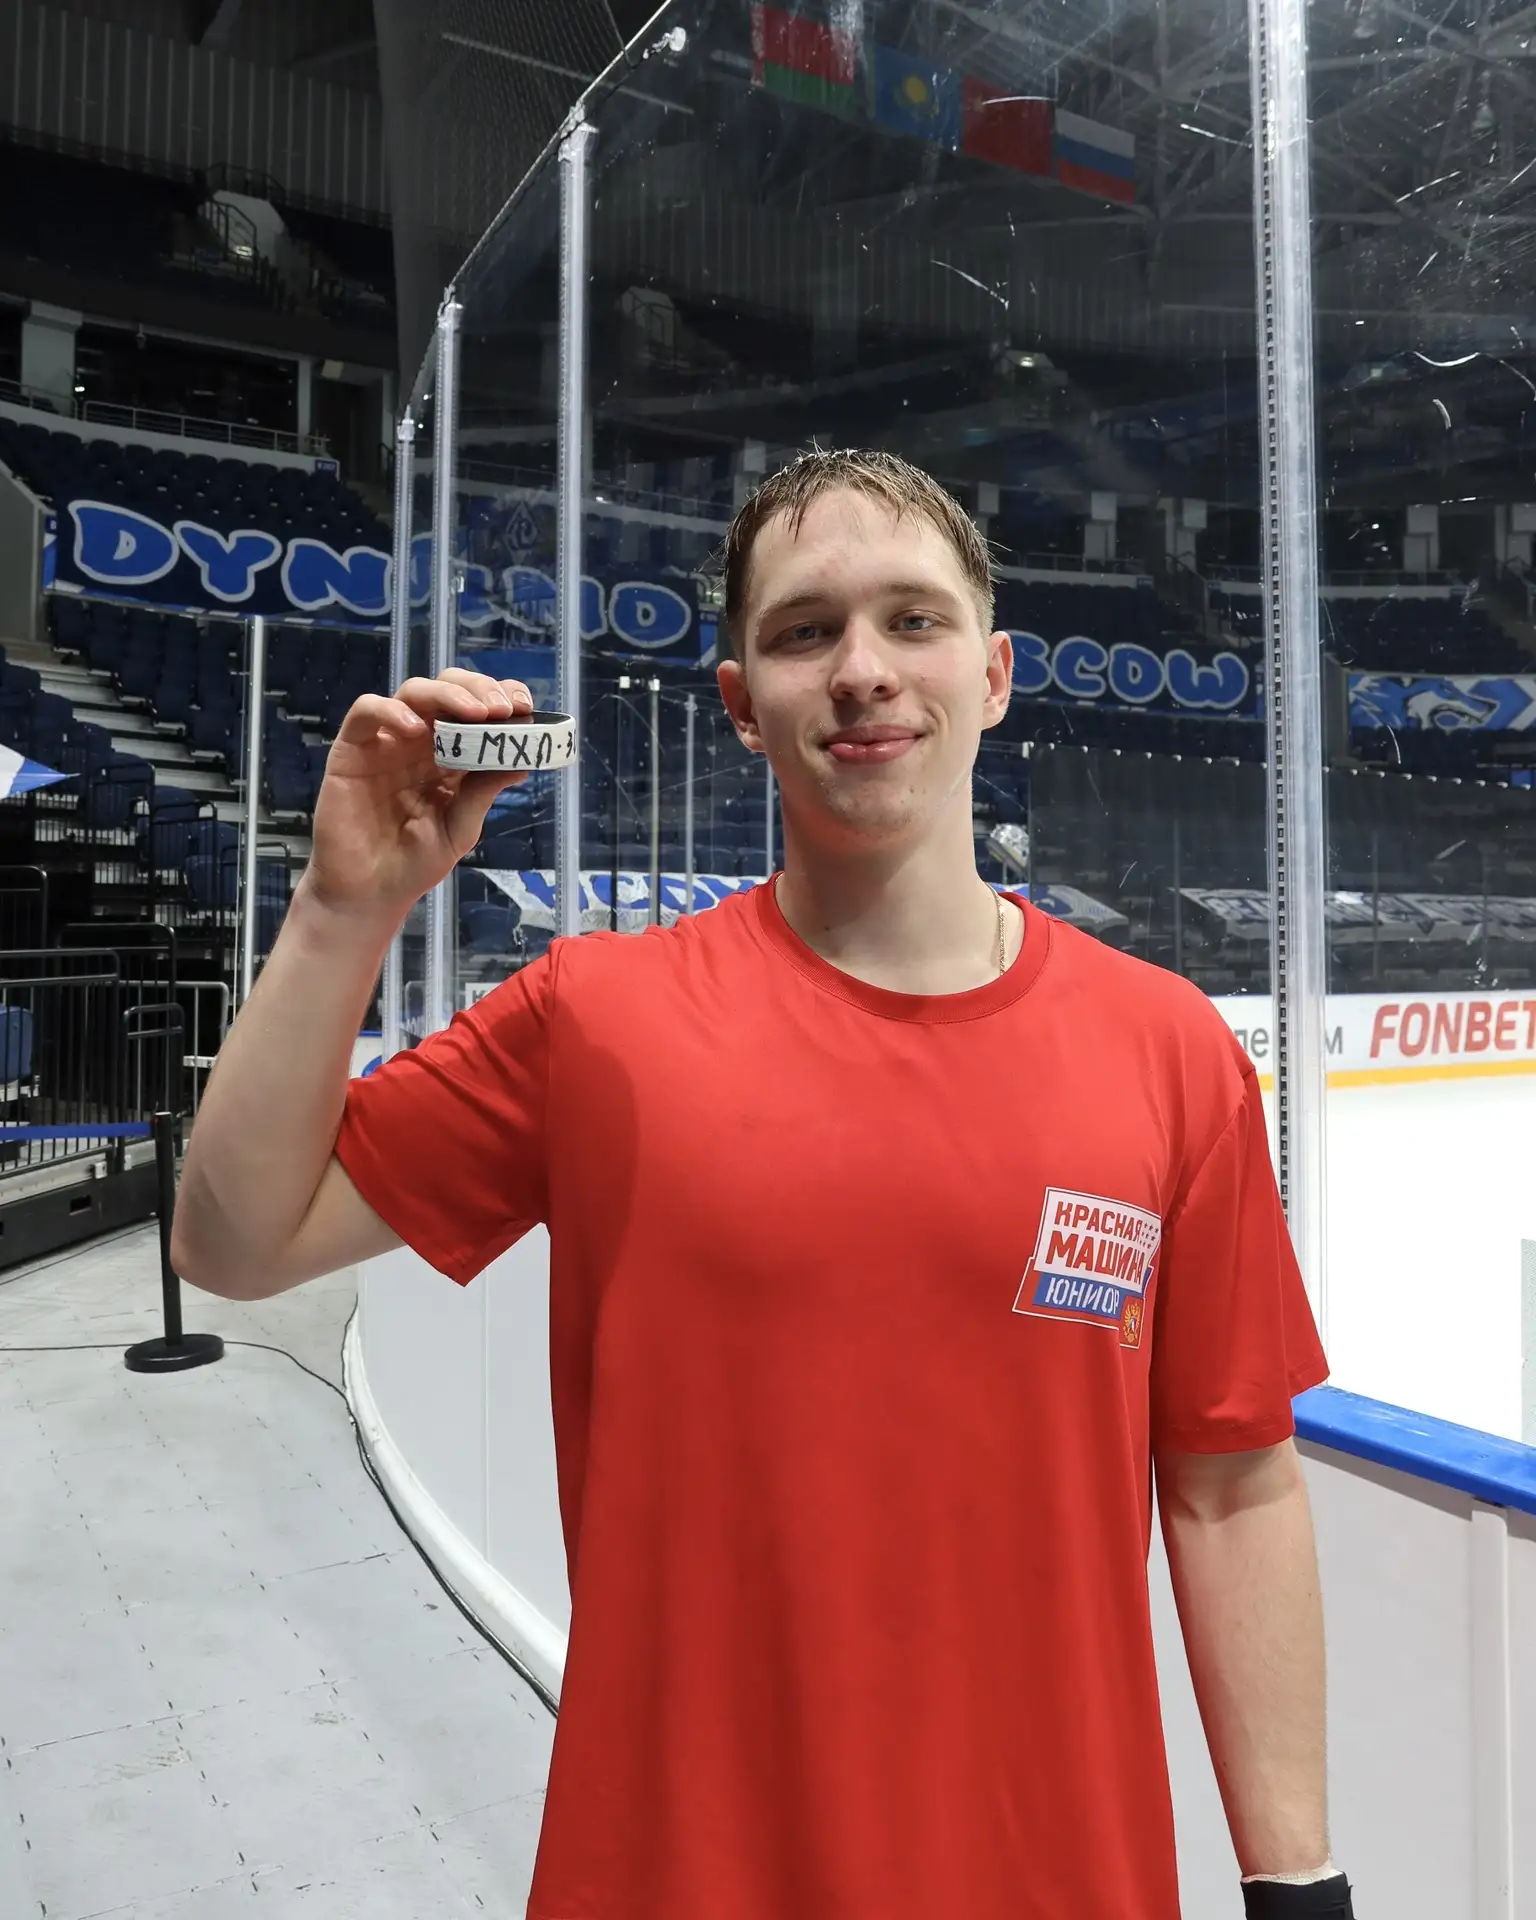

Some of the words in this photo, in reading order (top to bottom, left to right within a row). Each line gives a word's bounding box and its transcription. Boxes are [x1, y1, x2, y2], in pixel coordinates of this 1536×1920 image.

[1006, 629, 1249, 710] SCOW
[1369, 1000, 1536, 1059] FONBET
[1054, 1201, 1143, 1242] КРАСНАЯ
[1045, 1230, 1145, 1285] МАШИНА
[1045, 1277, 1120, 1315] ЮНИОР
